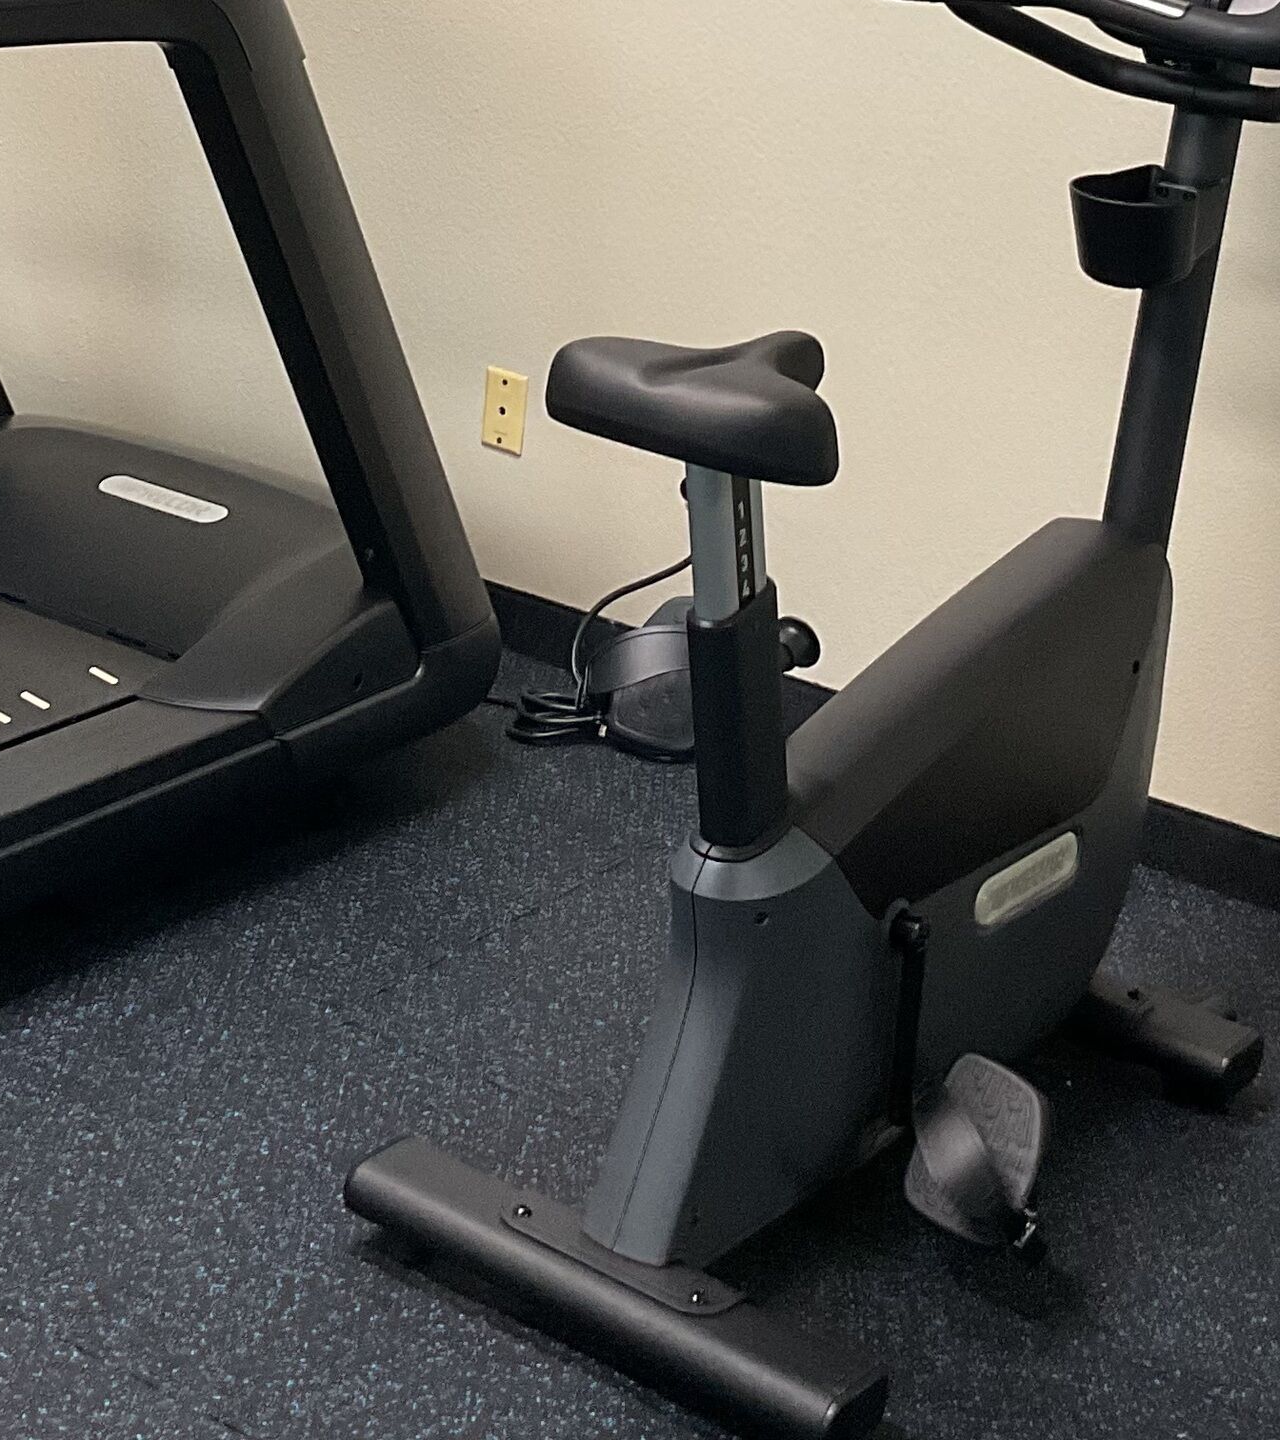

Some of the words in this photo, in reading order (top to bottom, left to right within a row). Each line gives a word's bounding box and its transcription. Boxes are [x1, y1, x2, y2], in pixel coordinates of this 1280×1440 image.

[738, 501, 744, 519] 1
[739, 527, 747, 548] 2
[740, 553, 749, 573] 3
